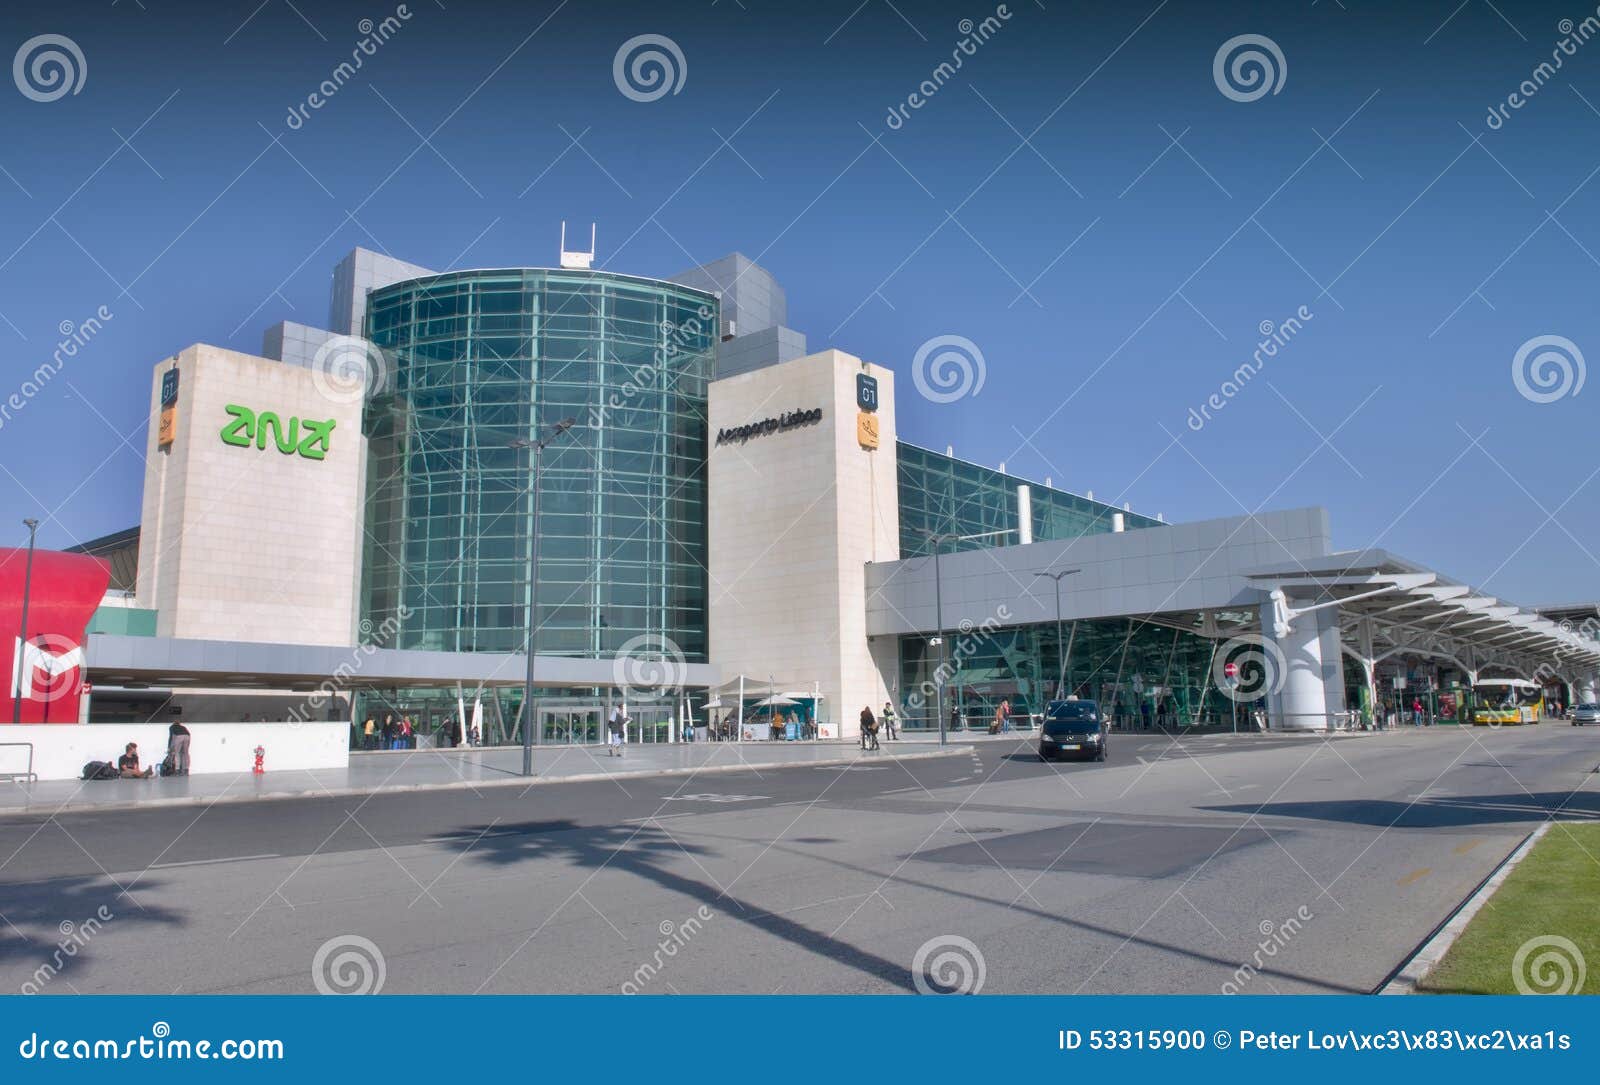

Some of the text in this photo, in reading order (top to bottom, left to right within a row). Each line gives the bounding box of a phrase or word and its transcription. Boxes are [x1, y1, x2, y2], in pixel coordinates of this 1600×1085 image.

[863, 388, 875, 404] 01
[716, 408, 822, 446] Aeroporto Lisboa
